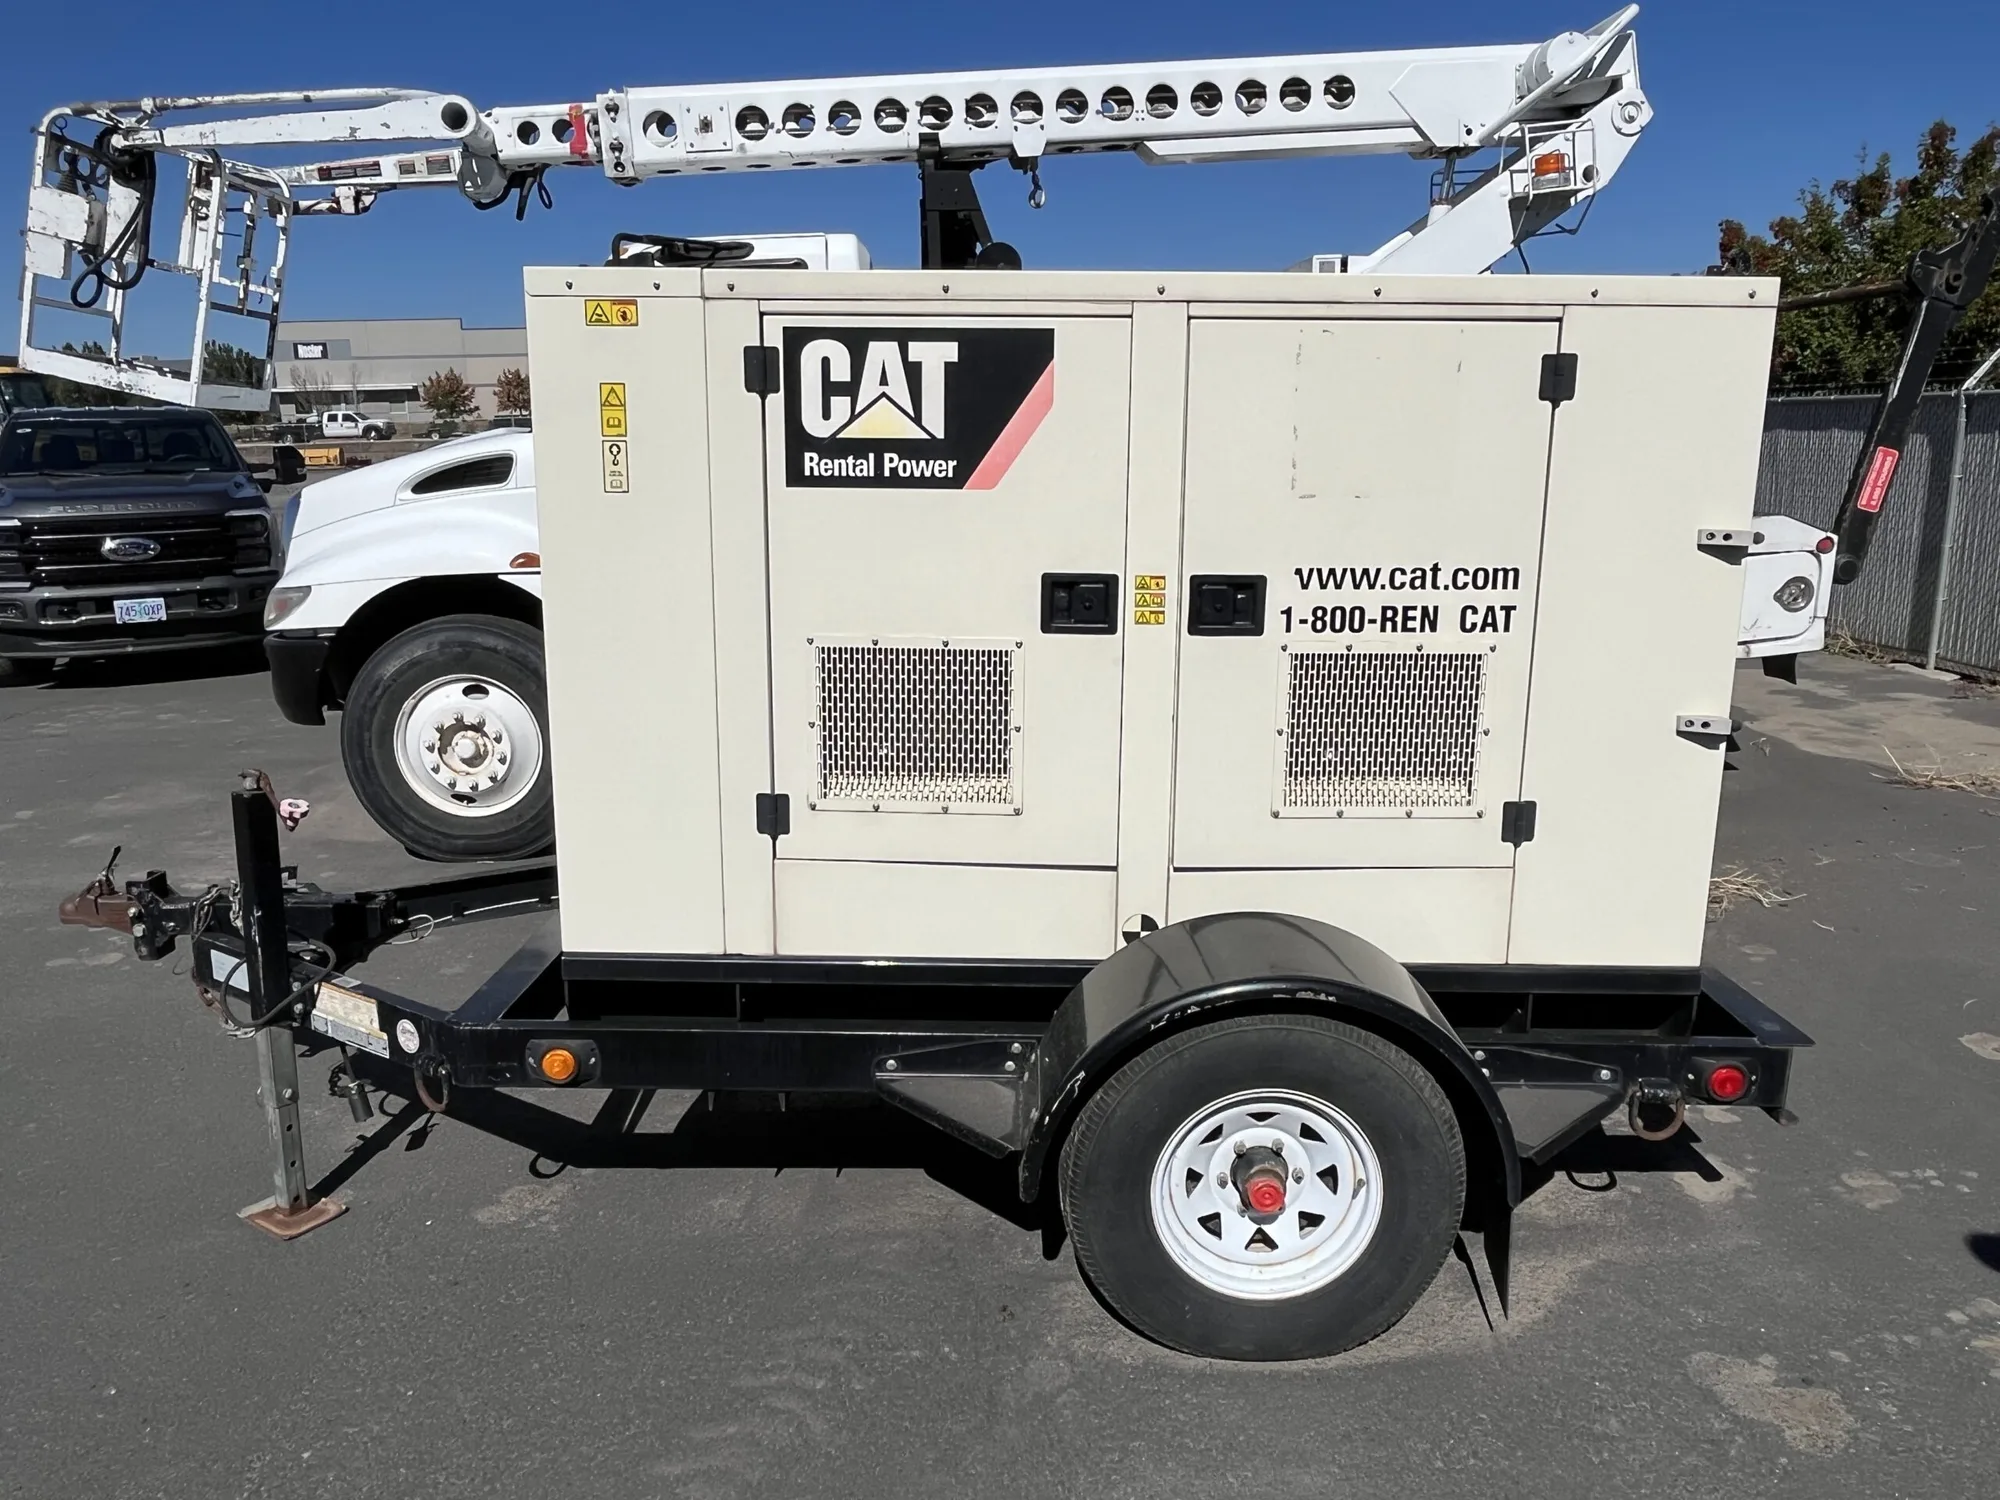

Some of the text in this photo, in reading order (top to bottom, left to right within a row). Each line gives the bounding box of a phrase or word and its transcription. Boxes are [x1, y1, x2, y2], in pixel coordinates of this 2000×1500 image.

[800, 338, 959, 440] CAT
[803, 451, 957, 477] Rental Power
[117, 605, 137, 618] 745
[1280, 604, 1517, 633] 1-800-REN CAT
